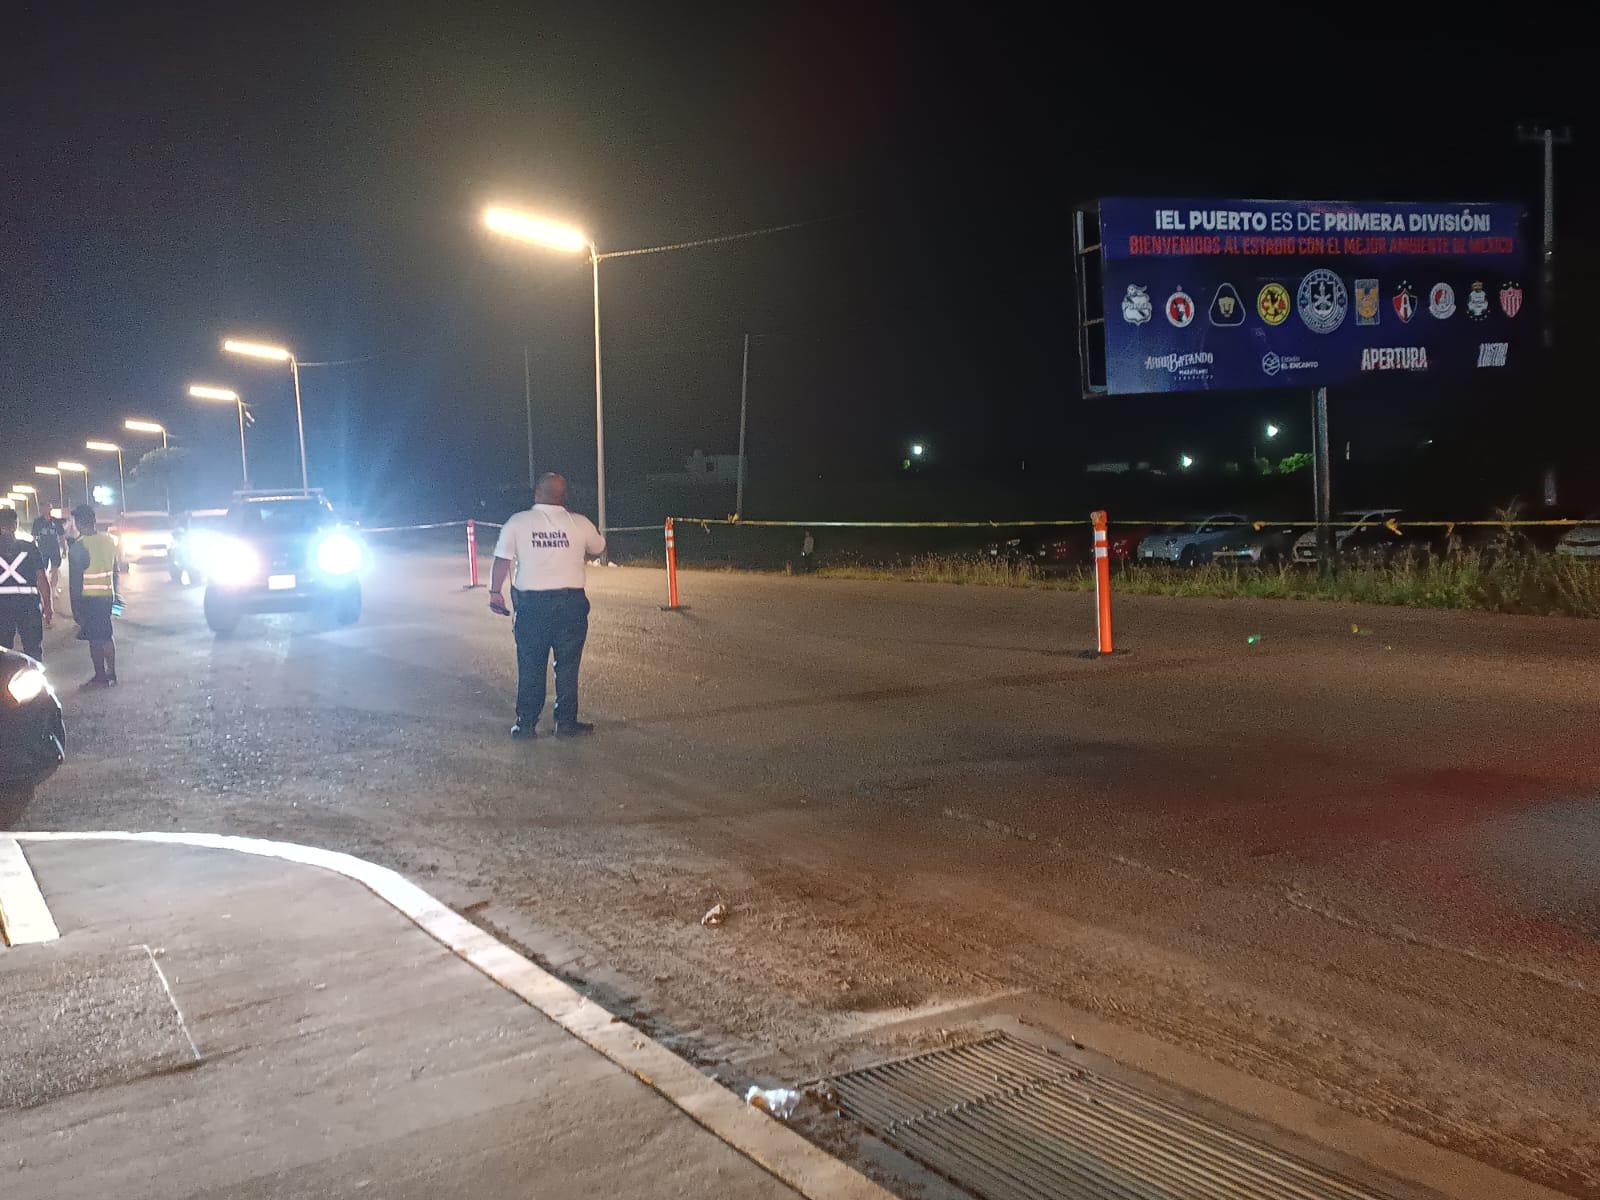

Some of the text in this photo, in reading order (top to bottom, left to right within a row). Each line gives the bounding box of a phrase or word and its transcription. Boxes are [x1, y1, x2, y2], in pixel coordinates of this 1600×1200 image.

[1189, 210, 1267, 231] PUERTO
[1271, 212, 1293, 231] ES
[1297, 212, 1321, 231] DE
[1324, 212, 1406, 232] PRIMERA
[1129, 235, 1220, 256] BIENVENIDOS
[1223, 236, 1240, 255] AL
[1243, 236, 1296, 255] ESTADIO
[1298, 236, 1326, 255] CON
[1327, 236, 1341, 254] EL
[1361, 346, 1428, 371] APERTURA
